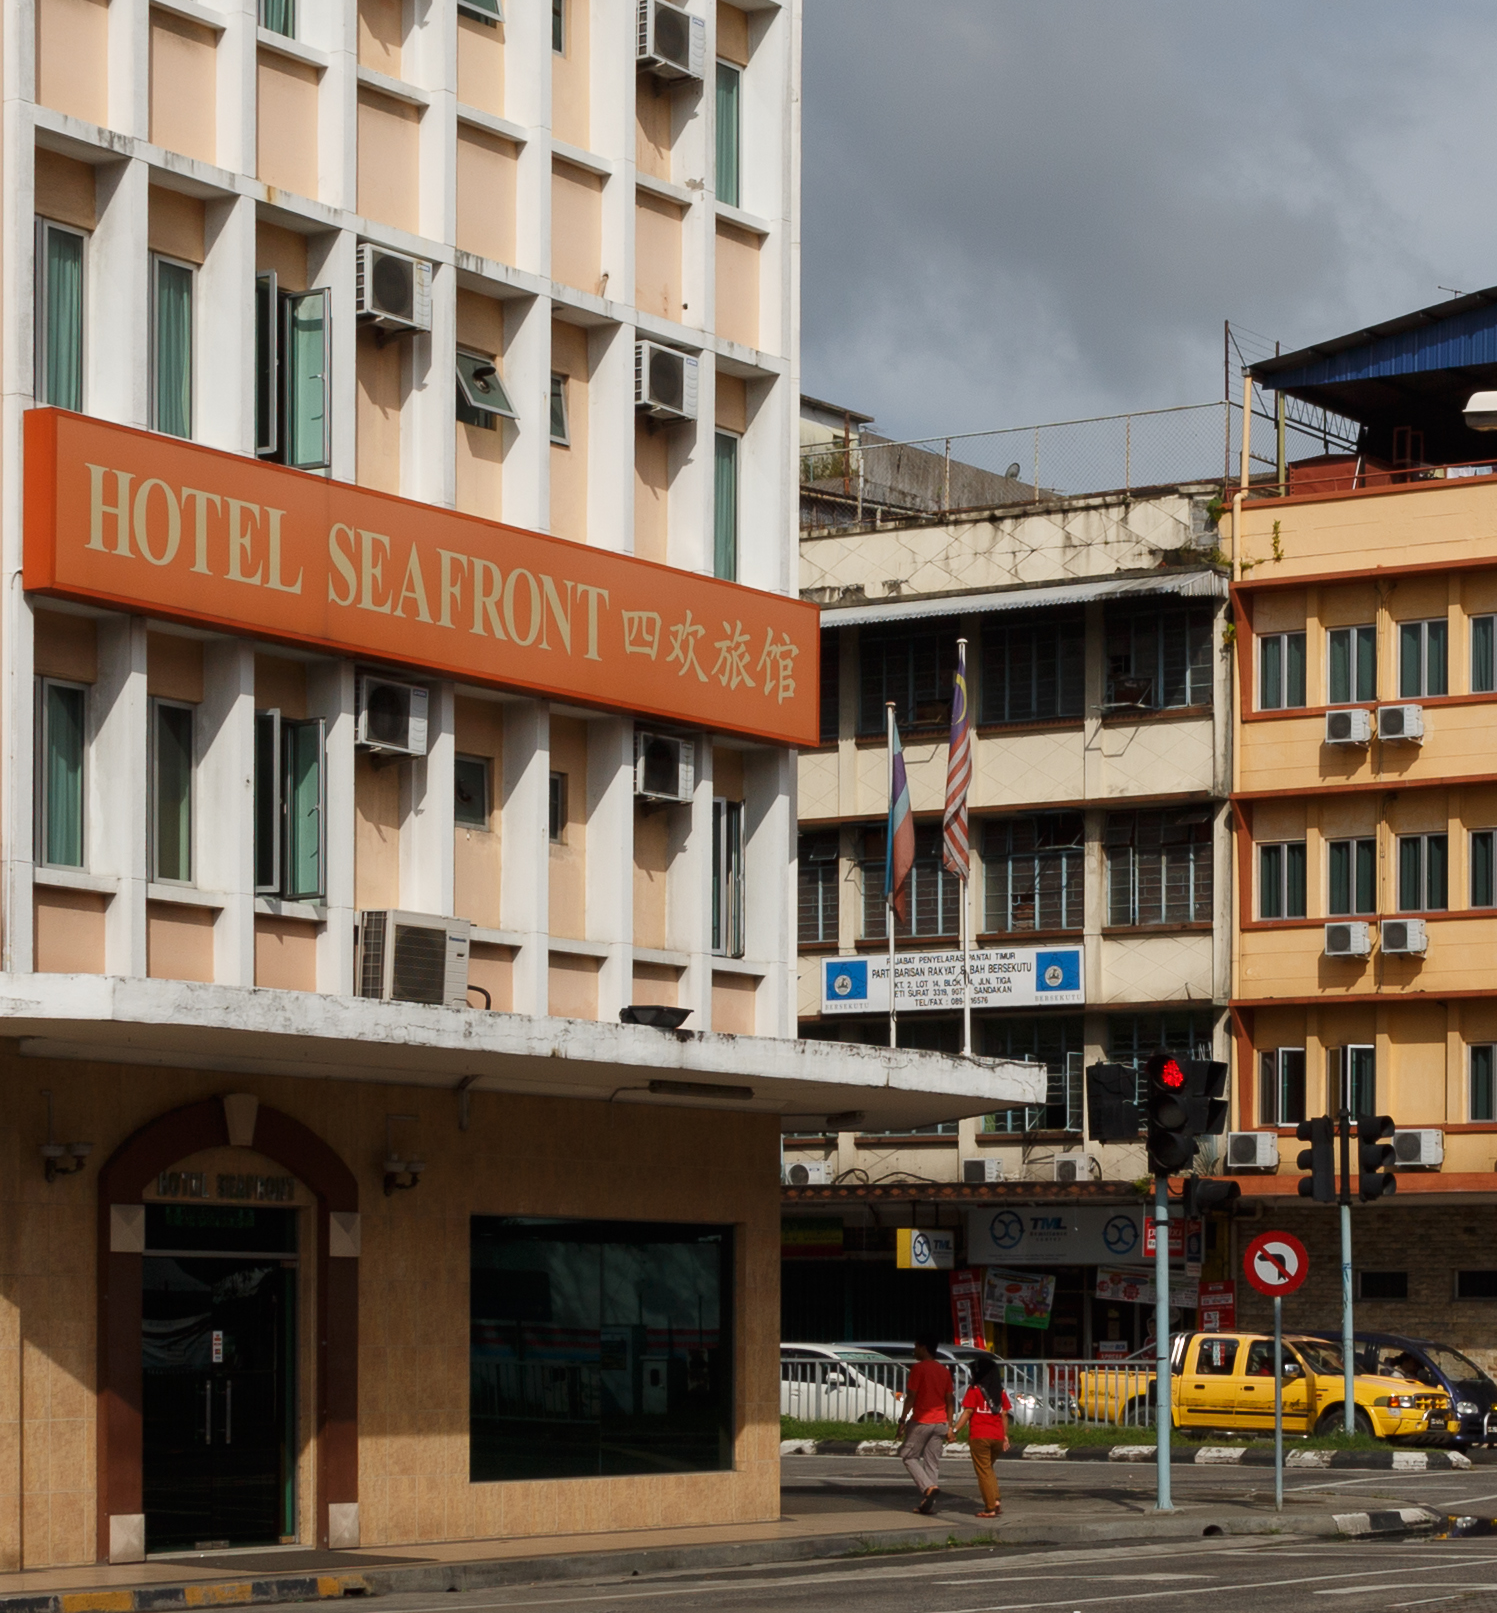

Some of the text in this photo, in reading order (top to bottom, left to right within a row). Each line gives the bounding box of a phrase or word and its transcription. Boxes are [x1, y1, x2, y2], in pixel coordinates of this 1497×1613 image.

[84, 463, 609, 661] HOTEL SEAFRONT
[621, 608, 799, 705] 四欢旅馆
[886, 956, 915, 965] PJABAT
[995, 952, 1016, 961] TIMUR
[988, 962, 1032, 974] BERSEKUTU
[974, 986, 1012, 994] SANDAKAN
[1029, 1217, 1067, 1230] TML
[933, 1239, 953, 1250] TML
